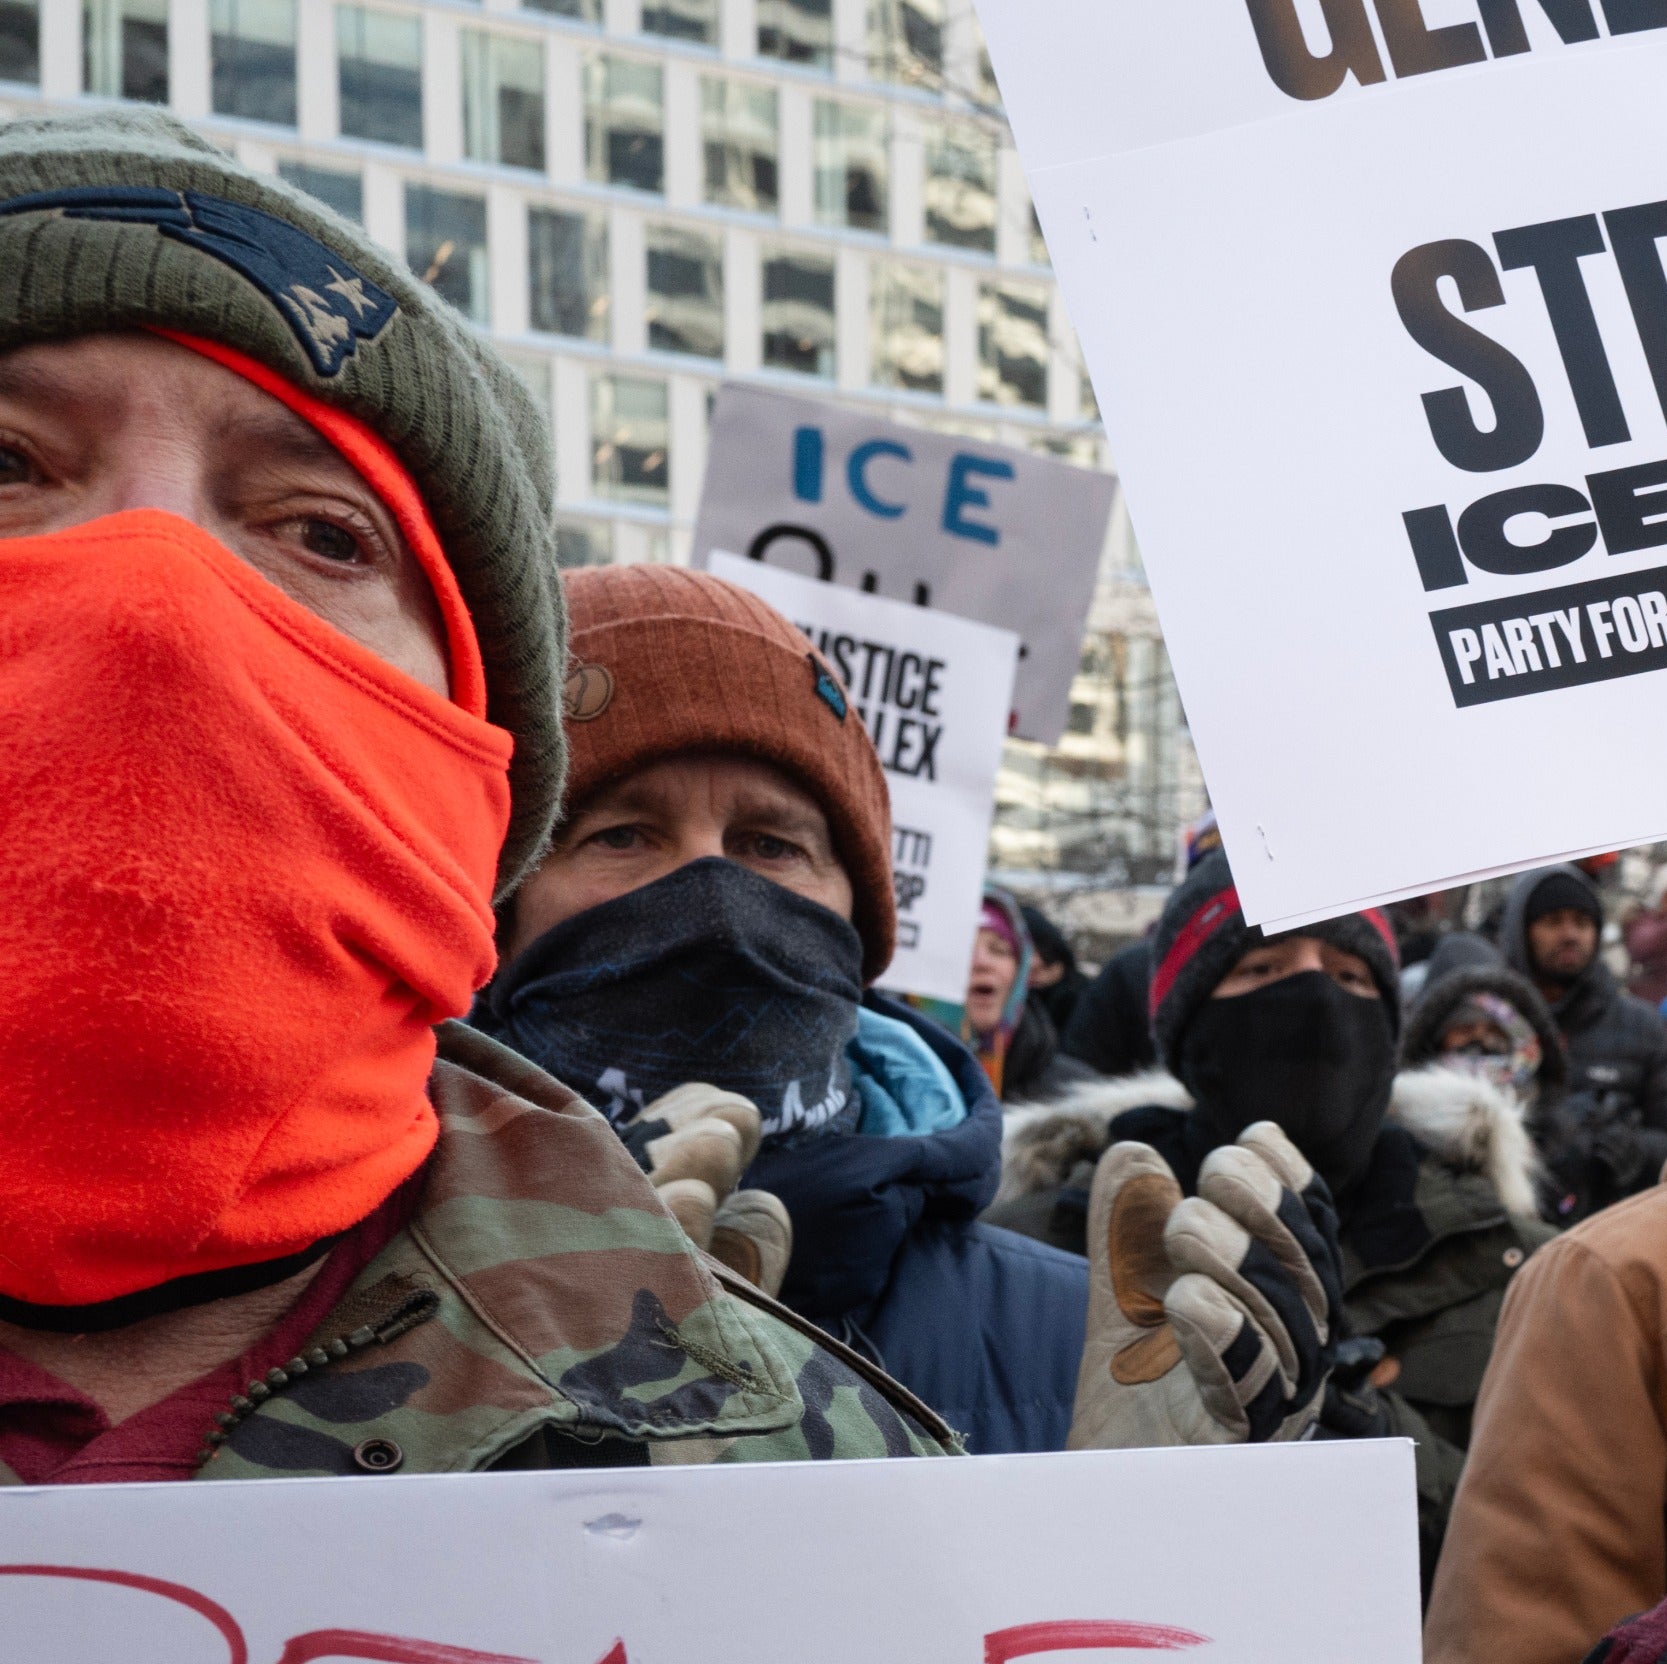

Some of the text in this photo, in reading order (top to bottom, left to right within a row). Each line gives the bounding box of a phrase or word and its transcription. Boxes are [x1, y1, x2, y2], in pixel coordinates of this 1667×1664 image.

[793, 427, 1016, 547] ICE
[796, 623, 945, 717] STICE
[1448, 607, 1587, 685] PARTY
[857, 706, 942, 783] LEX
